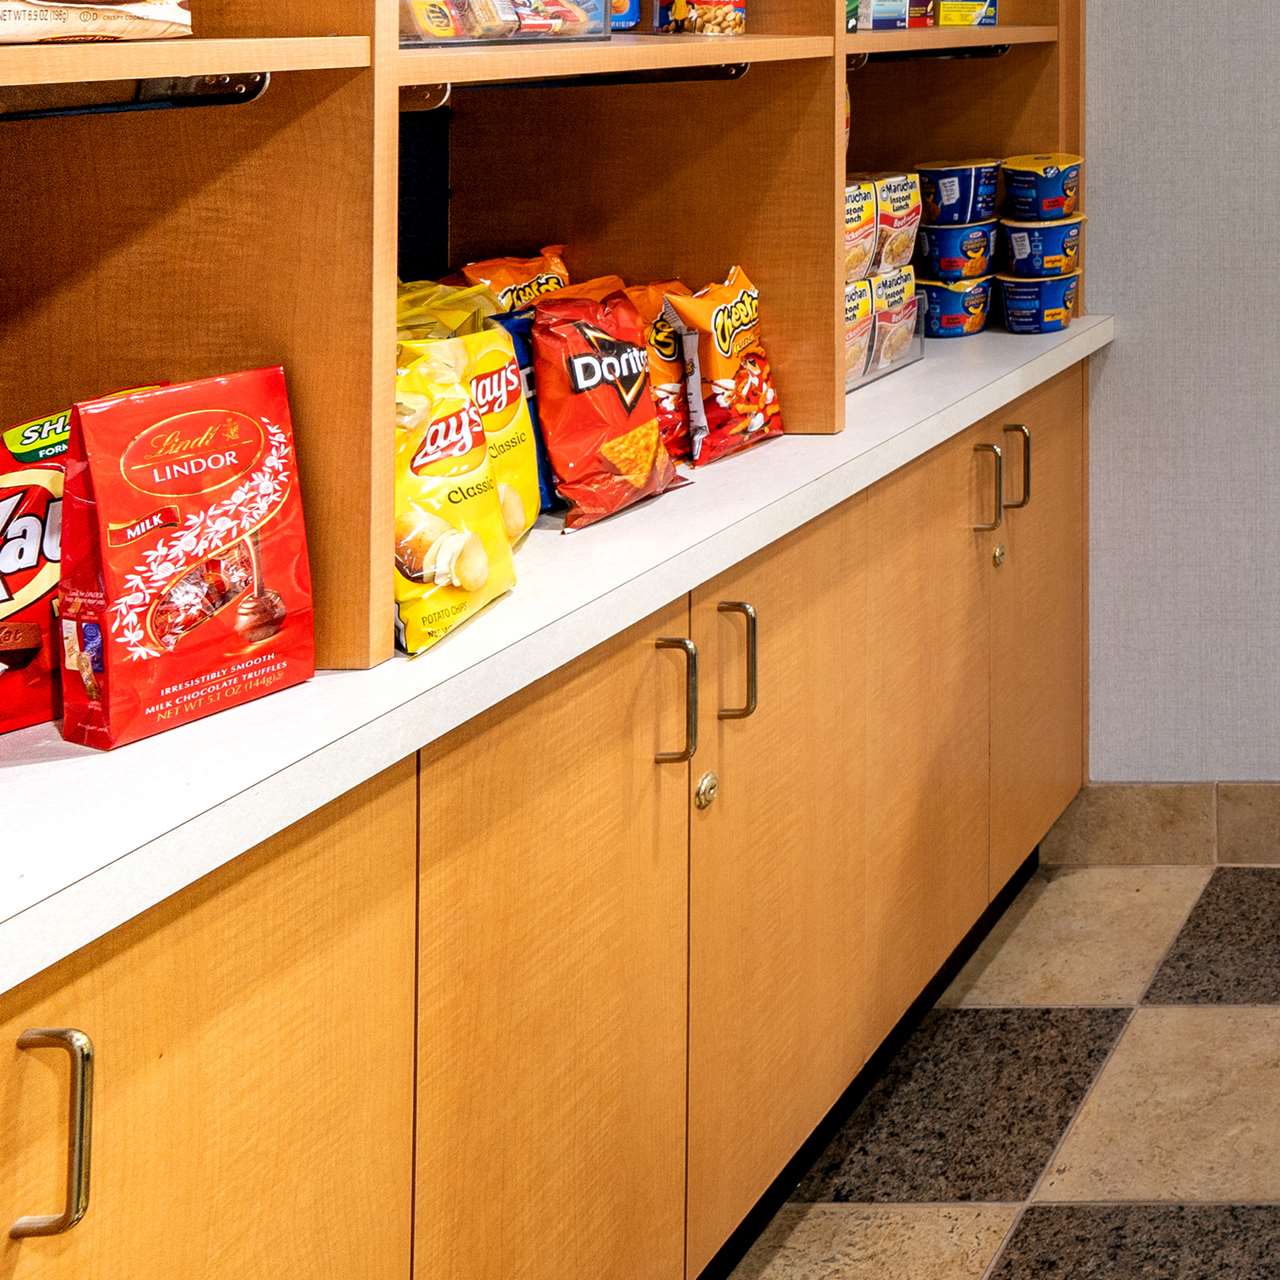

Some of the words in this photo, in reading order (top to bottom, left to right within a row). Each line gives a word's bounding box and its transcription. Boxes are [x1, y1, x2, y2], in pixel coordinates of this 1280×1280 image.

[886, 181, 916, 193] Maruchan
[890, 194, 910, 203] Instant
[893, 203, 909, 212] Lunch
[882, 273, 911, 287] Maruchan
[885, 287, 904, 299] Instant
[888, 297, 903, 308] Lunch
[145, 426, 219, 459] Lindt
[413, 397, 482, 467] Lay's
[488, 432, 526, 459] Classic
[153, 451, 238, 483] LINDOR
[447, 477, 494, 505] Classic
[126, 513, 163, 539] MILK
[422, 609, 450, 625] POTATO
[160, 669, 228, 696] IRRESISTIBLY
[230, 653, 275, 673] SMOOTH
[145, 700, 172, 714] MILK
[176, 678, 238, 704] CHOCOLATE
[242, 662, 287, 681] TRUFFLES
[157, 707, 179, 721] NET
[184, 699, 203, 712] WT
[224, 685, 241, 696] OZ
